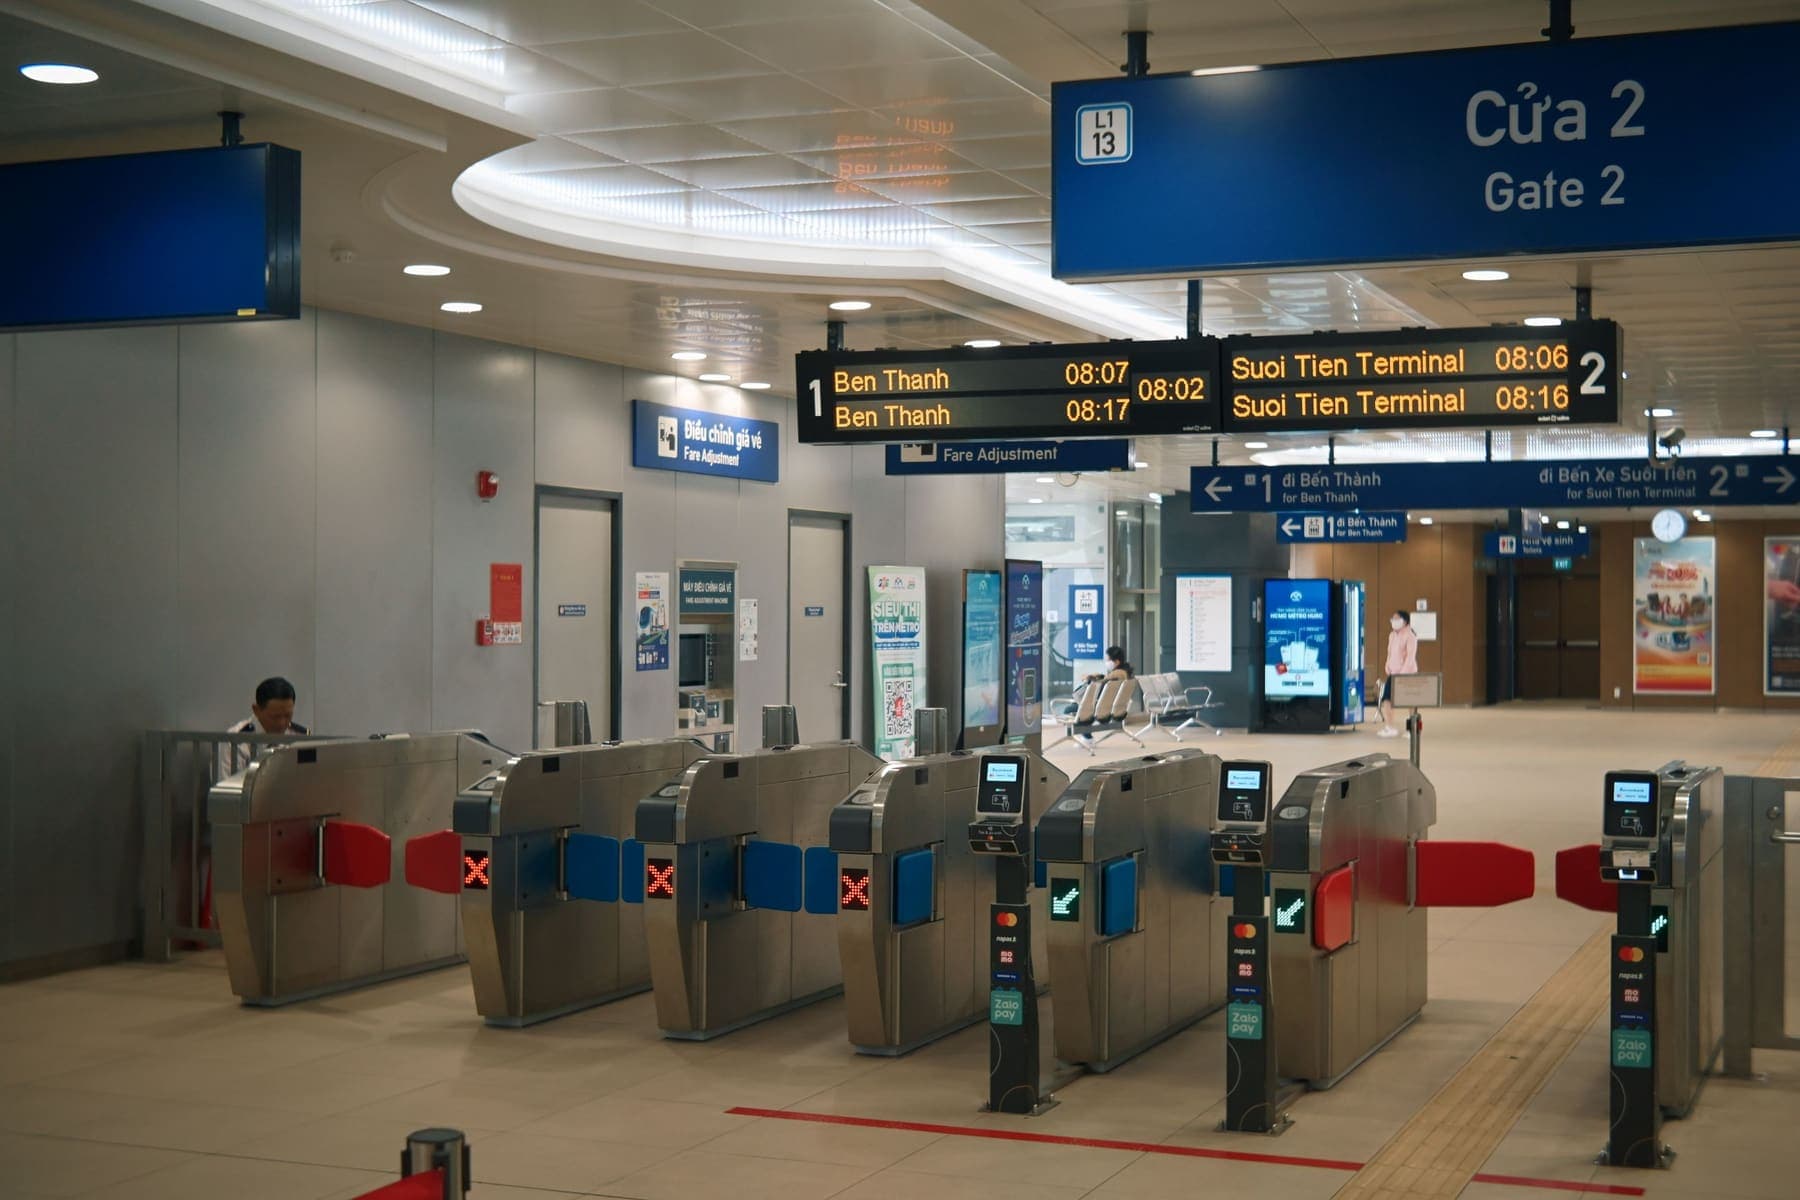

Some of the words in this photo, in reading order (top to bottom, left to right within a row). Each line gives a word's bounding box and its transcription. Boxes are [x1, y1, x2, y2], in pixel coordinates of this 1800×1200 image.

[1095, 110, 1113, 129] L1
[1466, 81, 1586, 147] Cửa
[1610, 79, 1645, 138] 2
[1093, 131, 1115, 156] 13
[1484, 169, 1584, 212] Gate
[1600, 164, 1625, 206] 2
[1232, 355, 1286, 380] Suoi
[1294, 354, 1348, 378] Tien
[1355, 348, 1465, 376] Terminal
[1495, 344, 1569, 371] 08:06
[1579, 351, 1606, 395] 2
[834, 371, 877, 393] Ben
[882, 368, 949, 391] Thanh
[1065, 361, 1129, 385] 08:07
[808, 379, 822, 417] 1
[1138, 377, 1205, 401] 08:02
[1232, 393, 1286, 418] Suoi
[1295, 392, 1349, 416] Tien
[1356, 387, 1465, 414] Terminal
[1495, 384, 1569, 411] 08:16
[835, 406, 878, 428] Ben
[884, 404, 951, 427] Thanh
[1066, 398, 1130, 422] 08:17
[708, 423, 735, 446] chỉnh
[736, 428, 750, 452] giá
[751, 430, 762, 450] vé
[684, 445, 701, 461] Fare
[701, 448, 739, 467] Adjustment
[944, 448, 973, 462] Fare
[977, 446, 1058, 464] Adjustment
[1282, 472, 1295, 488] đi
[1300, 470, 1329, 488] Bến
[1333, 471, 1381, 487] Thành
[1539, 467, 1553, 484] đi
[1558, 464, 1590, 483] Bến
[1595, 466, 1615, 482] Xe
[1709, 465, 1729, 497] 2
[1262, 474, 1271, 503] 1
[1282, 492, 1297, 503] for
[1301, 492, 1321, 503] Ben
[1324, 492, 1358, 503] Thanh
[1567, 487, 1583, 499] for
[1586, 487, 1612, 499] Suoi
[1615, 487, 1640, 498] Tien
[1643, 486, 1696, 498] Terminal
[1327, 516, 1335, 538] 1
[994, 1009, 1016, 1020] pay
[995, 1000, 1019, 1009] Zalo
[1232, 1013, 1258, 1023] Zalo
[1232, 1024, 1255, 1035] pay
[1618, 1039, 1647, 1050] Zalo
[1617, 1051, 1643, 1063] pay
